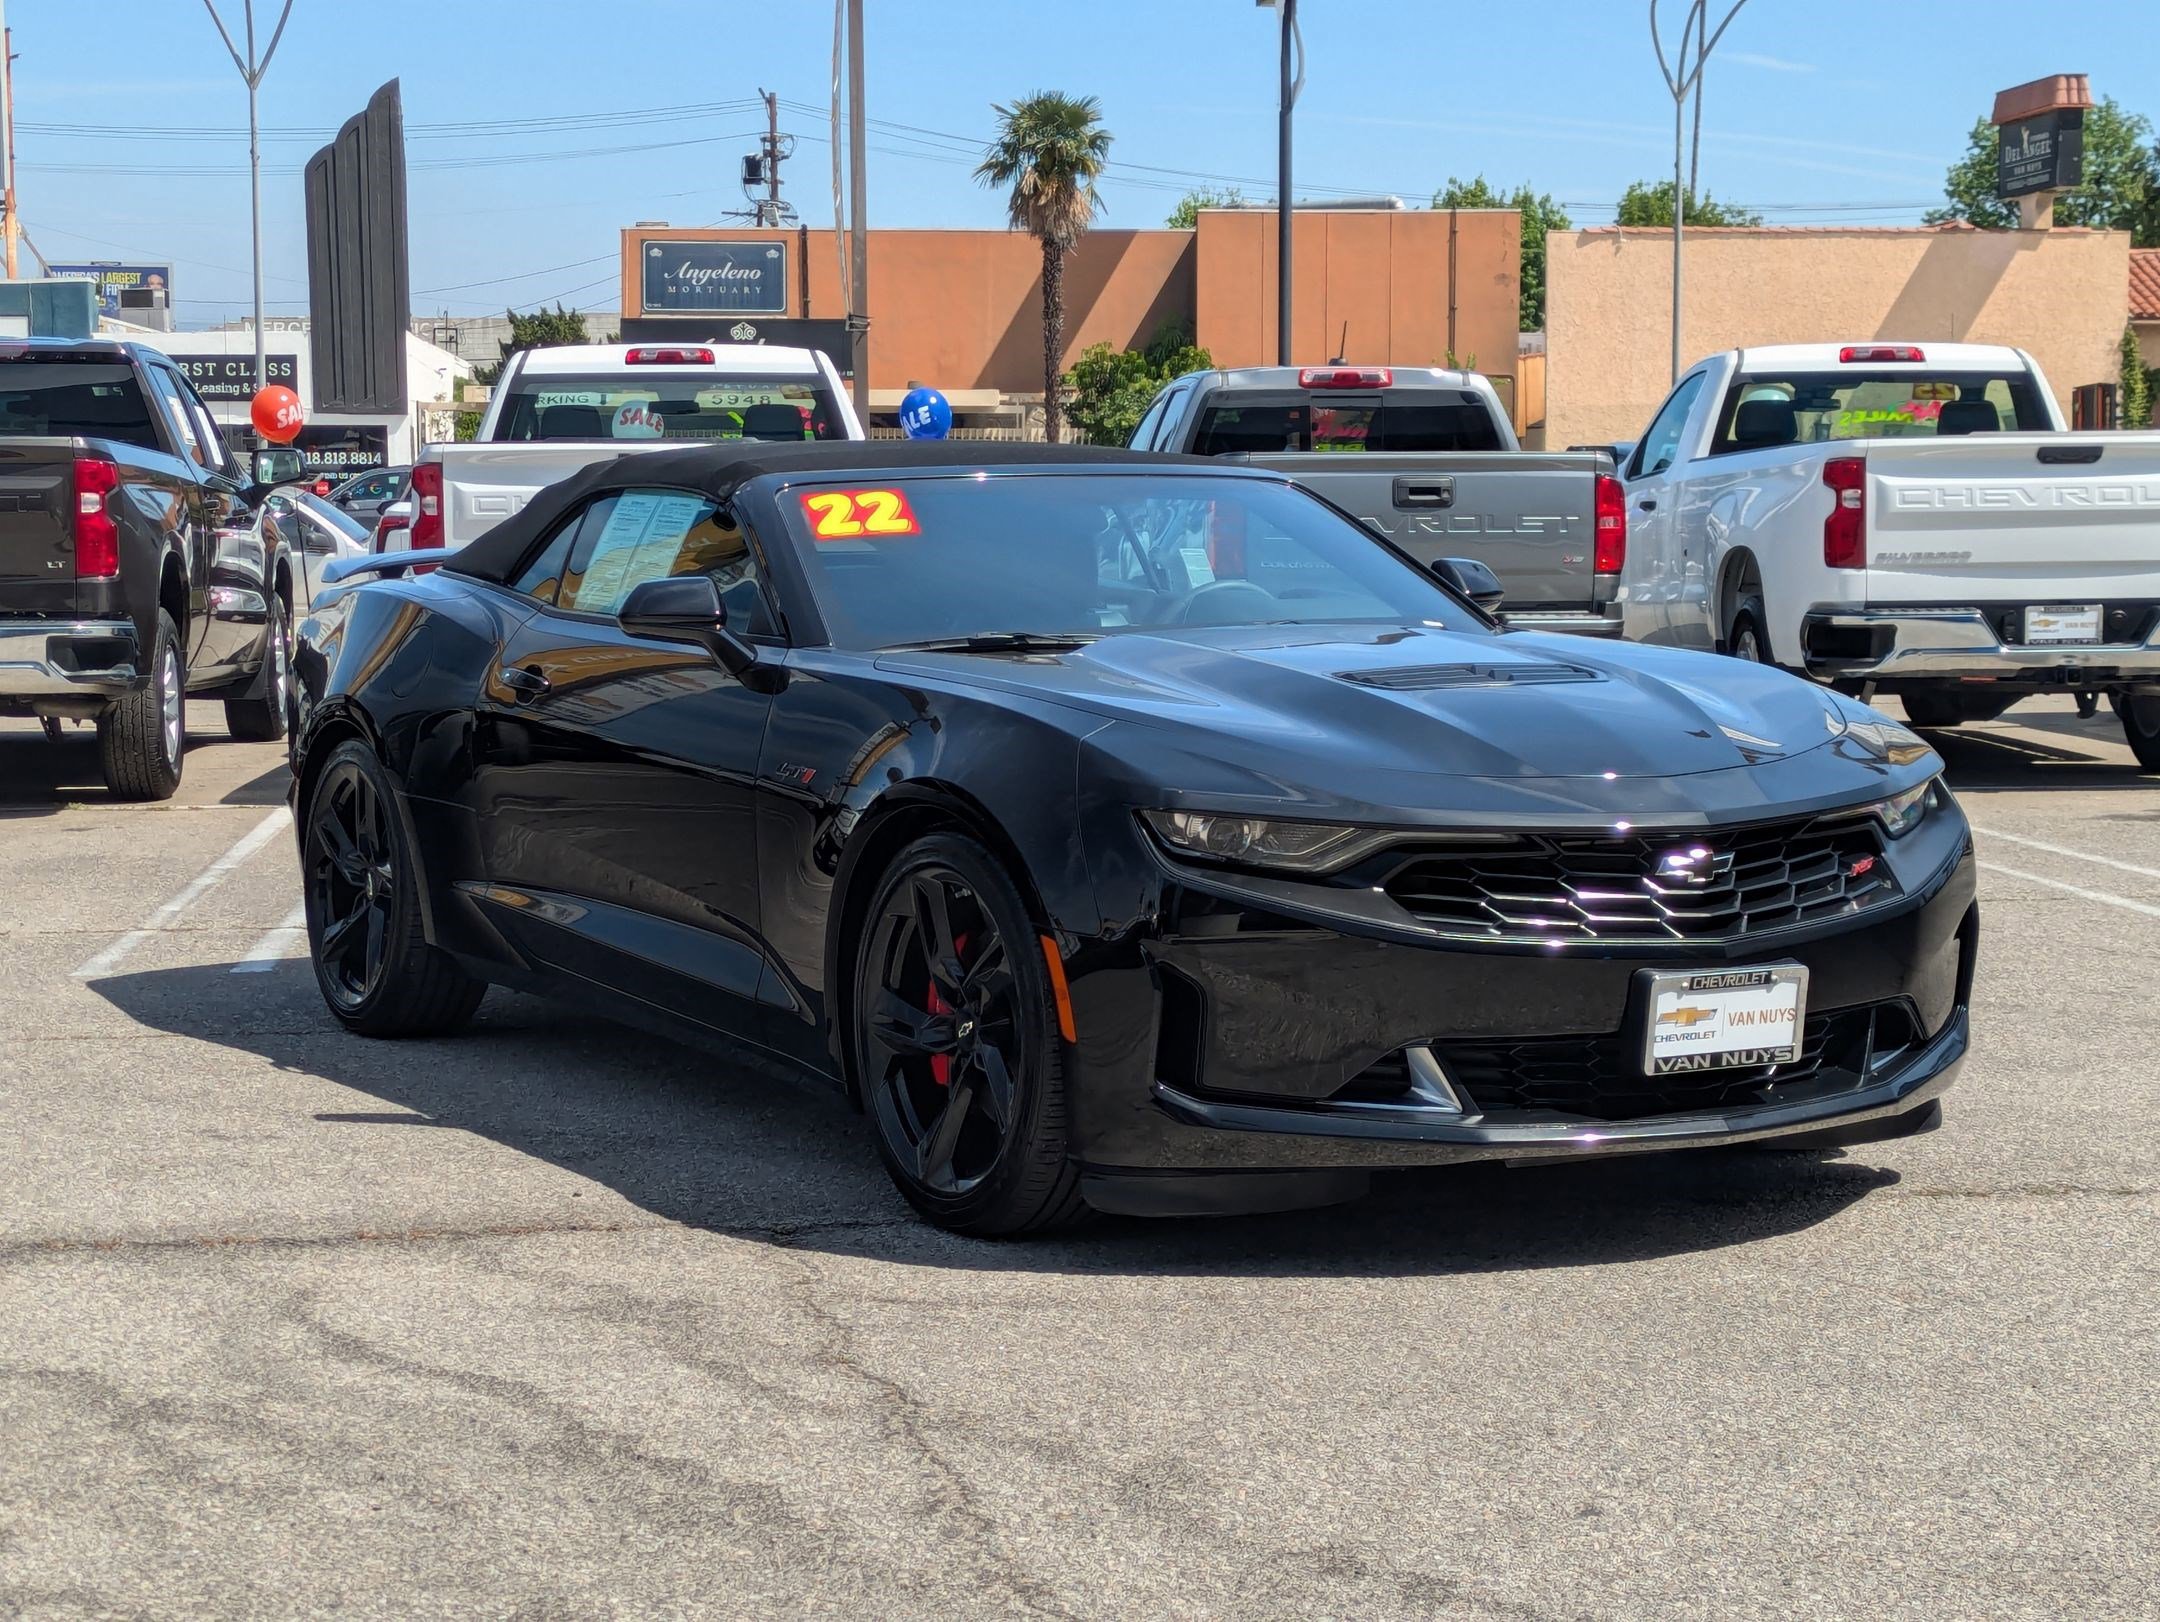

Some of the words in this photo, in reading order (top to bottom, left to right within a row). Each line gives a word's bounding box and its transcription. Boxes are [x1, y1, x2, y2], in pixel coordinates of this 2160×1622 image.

[101, 272, 141, 284] LARGEST
[663, 260, 762, 286] Angeleno
[667, 286, 762, 294] MORTUARY
[178, 362, 216, 376] RST
[225, 362, 291, 376] CLSS
[242, 383, 251, 393] &
[536, 394, 589, 405] RKING
[711, 394, 771, 405] 5948
[276, 401, 303, 429] SAL
[619, 407, 663, 432] SALE
[902, 405, 931, 432] ALE
[304, 452, 382, 465] 18.818.8814
[807, 491, 912, 537] 22
[1360, 514, 1580, 534] VROLET
[1692, 971, 1769, 990] CHEVROLET
[1728, 1011, 1755, 1027] VAN
[1759, 1007, 1798, 1025] NUYS
[1653, 1030, 1717, 1044] CHEVROLET
[1656, 1053, 1712, 1073] VAN
[1721, 1046, 1794, 1068] NUYS
